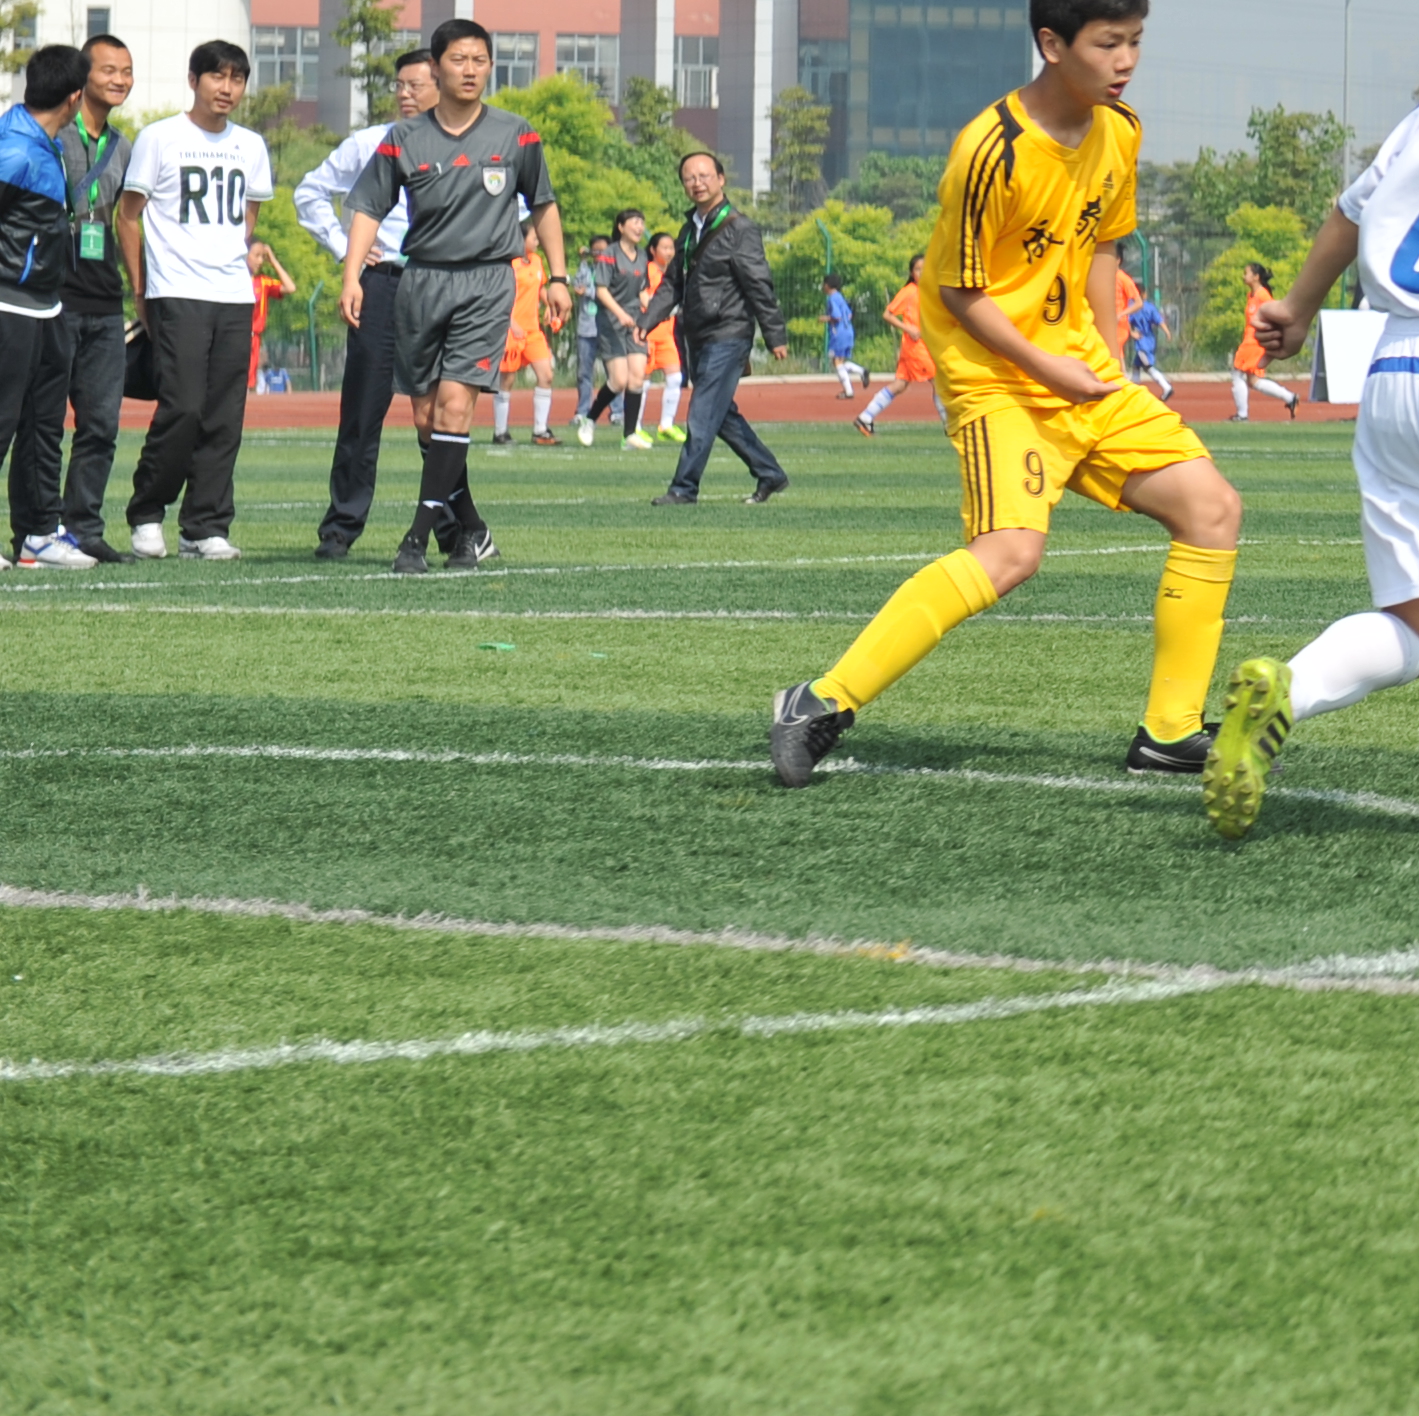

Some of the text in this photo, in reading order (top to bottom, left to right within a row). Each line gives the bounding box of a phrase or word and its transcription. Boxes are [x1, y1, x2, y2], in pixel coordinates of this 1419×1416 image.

[179, 165, 246, 226] R10
[1042, 271, 1069, 327] 9
[1022, 447, 1046, 499] 9
